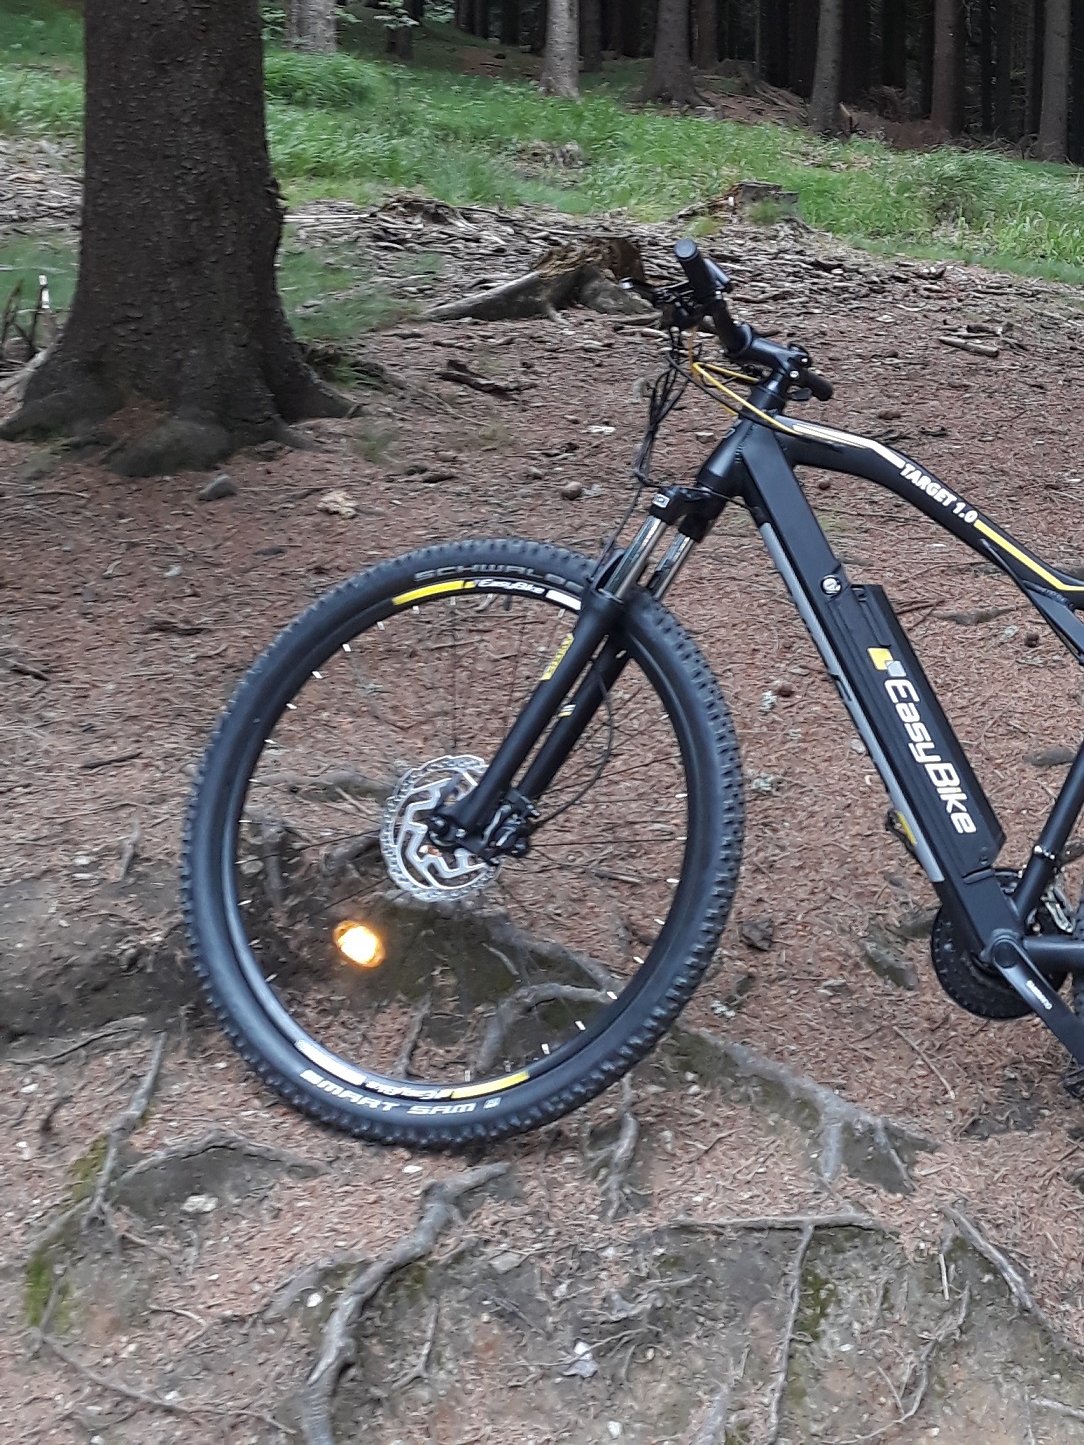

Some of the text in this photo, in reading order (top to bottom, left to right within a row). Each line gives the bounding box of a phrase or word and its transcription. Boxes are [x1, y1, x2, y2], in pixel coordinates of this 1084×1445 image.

[899, 463, 979, 524] TARGET 1.0
[406, 1102, 478, 1116] SAM
